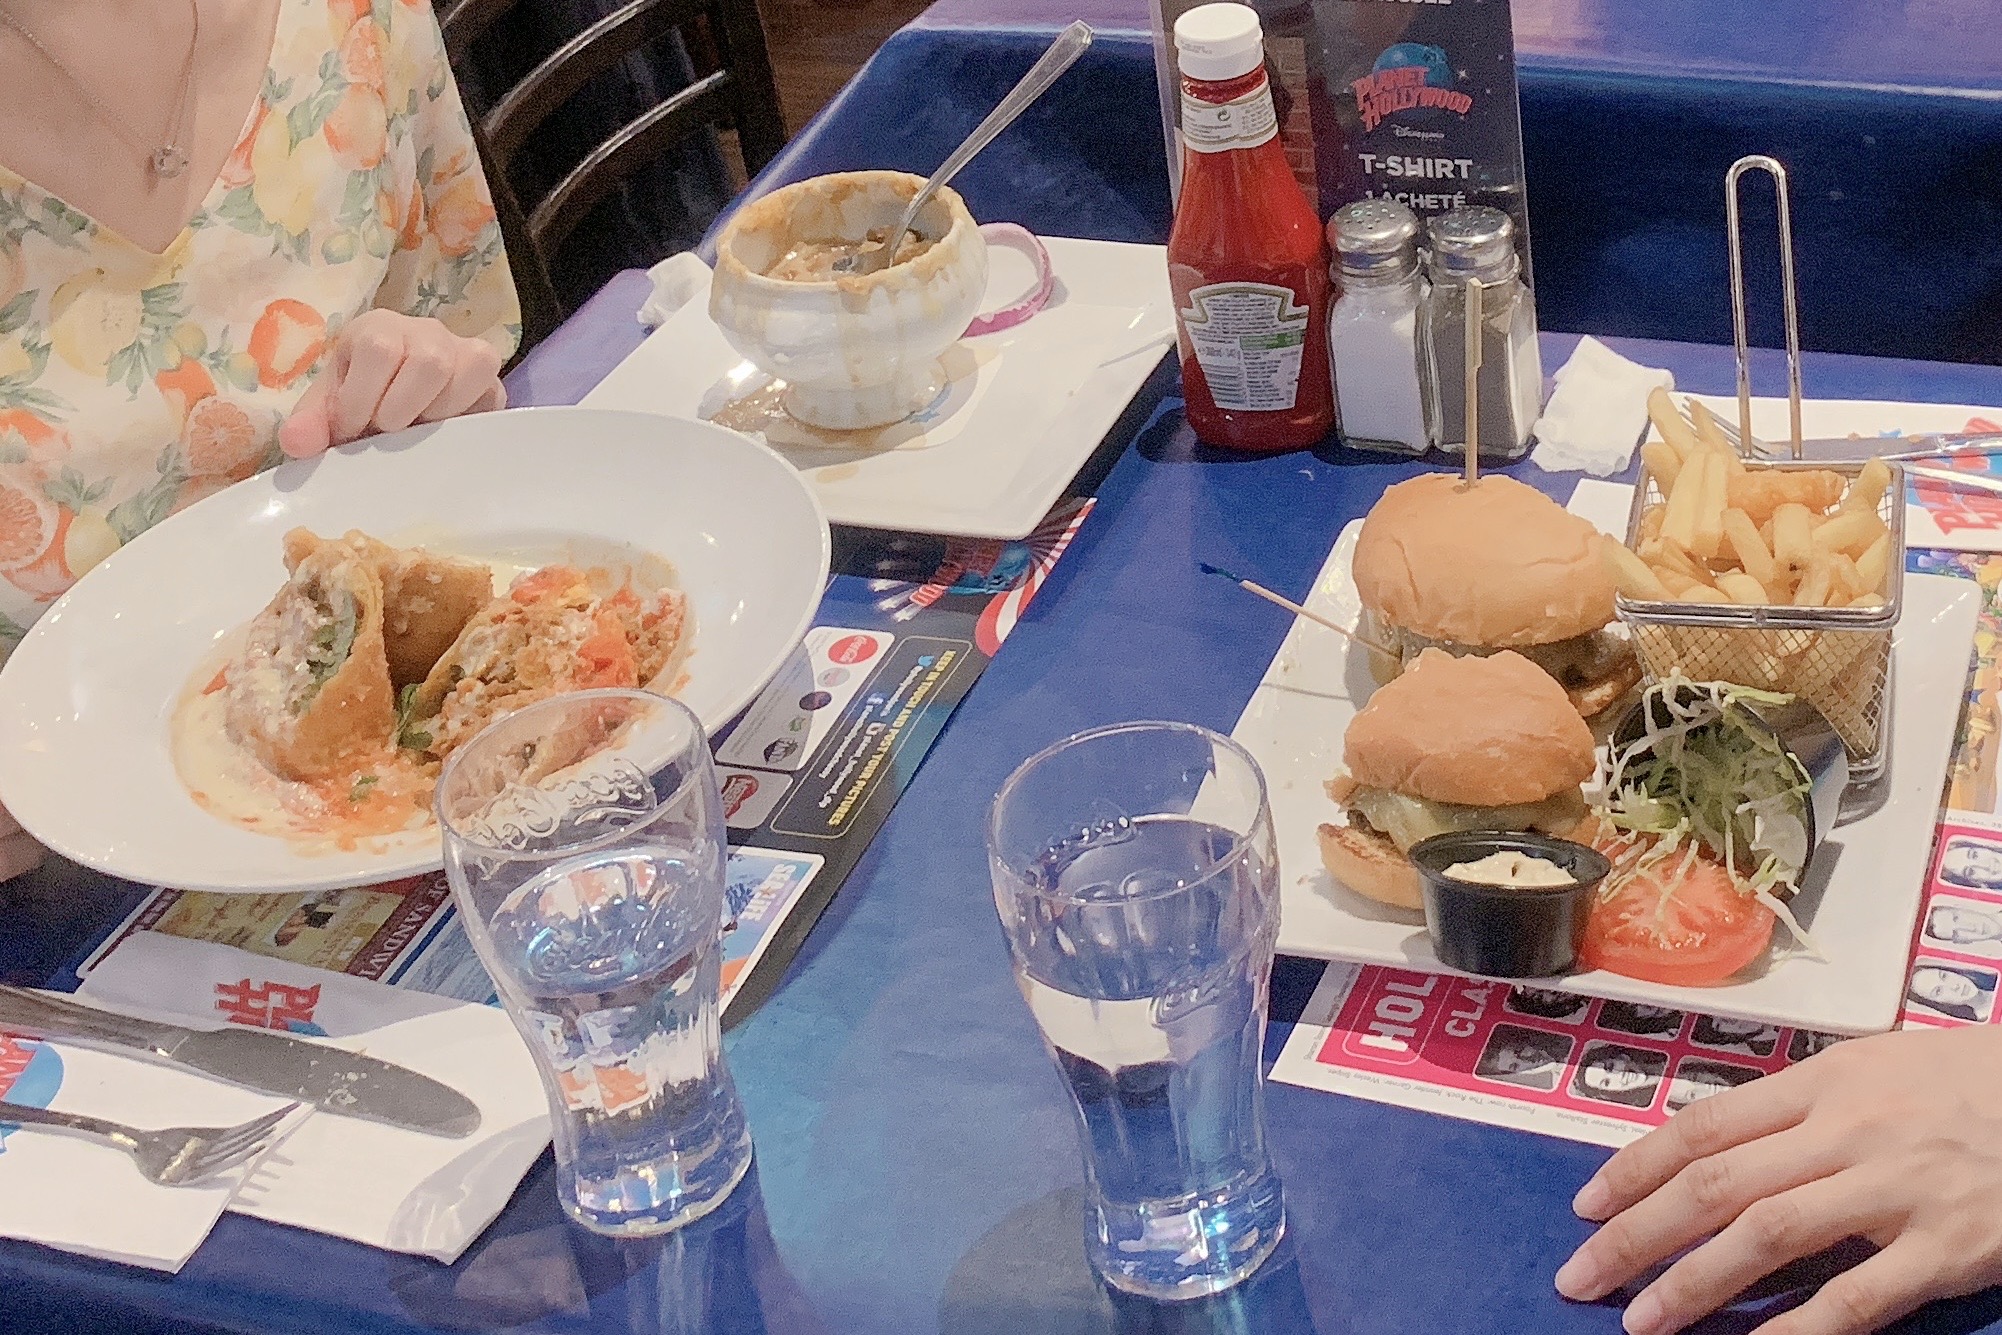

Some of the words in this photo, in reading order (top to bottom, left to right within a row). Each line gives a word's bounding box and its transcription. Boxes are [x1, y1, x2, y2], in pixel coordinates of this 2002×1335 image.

[1350, 66, 1430, 111] PLANET
[1361, 87, 1473, 132] HOLLYWOOD
[1358, 153, 1473, 179] T-SHIRT
[934, 650, 957, 672] KEEP
[925, 671, 941, 682] IN
[905, 680, 934, 709] TOUCH
[892, 708, 913, 728] AND
[876, 728, 900, 753] POST
[858, 752, 884, 780] YOUR
[827, 779, 867, 826] PICTURES
